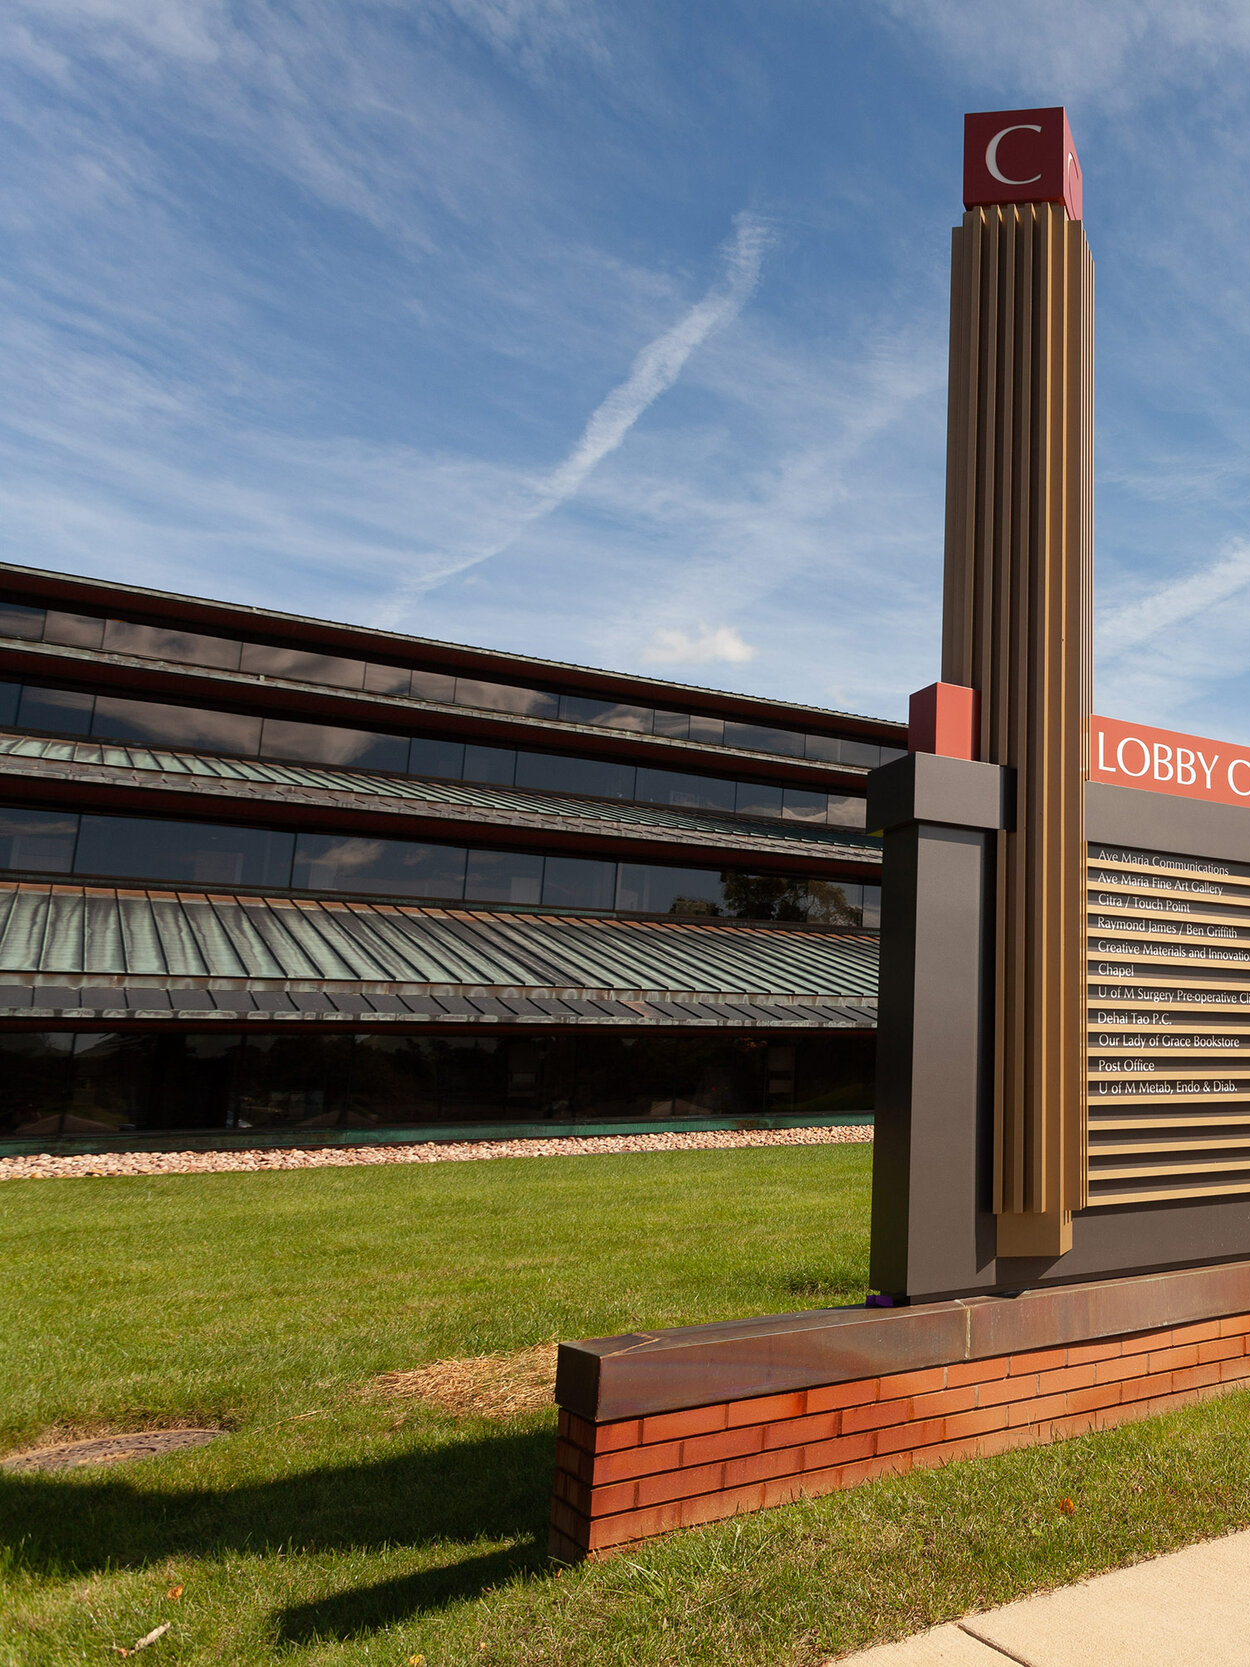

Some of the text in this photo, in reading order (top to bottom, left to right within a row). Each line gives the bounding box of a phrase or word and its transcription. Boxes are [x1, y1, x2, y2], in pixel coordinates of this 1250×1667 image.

[985, 124, 1042, 185] C
[1098, 731, 1219, 789] LOBBY
[1098, 850, 1229, 876] Ave Maria Communications
[1098, 872, 1223, 896] Ave Maria Fine Art Gallery
[1098, 894, 1190, 913] Citra / Touch Point
[1098, 917, 1238, 939] Raymond James / Ben Griffith
[1098, 941, 1140, 955] Creative
[1142, 944, 1186, 958] Materials
[1188, 947, 1206, 960] and
[1098, 963, 1134, 978] Chapel
[1098, 986, 1107, 998] U
[1110, 986, 1121, 999] of
[1123, 988, 1135, 999] M
[1137, 988, 1174, 1003] Surgery
[1177, 990, 1237, 1005] Pre-operative
[1098, 1012, 1172, 1025] Dehai Tao P.C.
[1099, 1034, 1240, 1049] Our Lady of Grace Bookstore
[1098, 1059, 1155, 1072] Post Office
[1099, 1080, 1238, 1094] U of M Metab, Endo & Diab.
